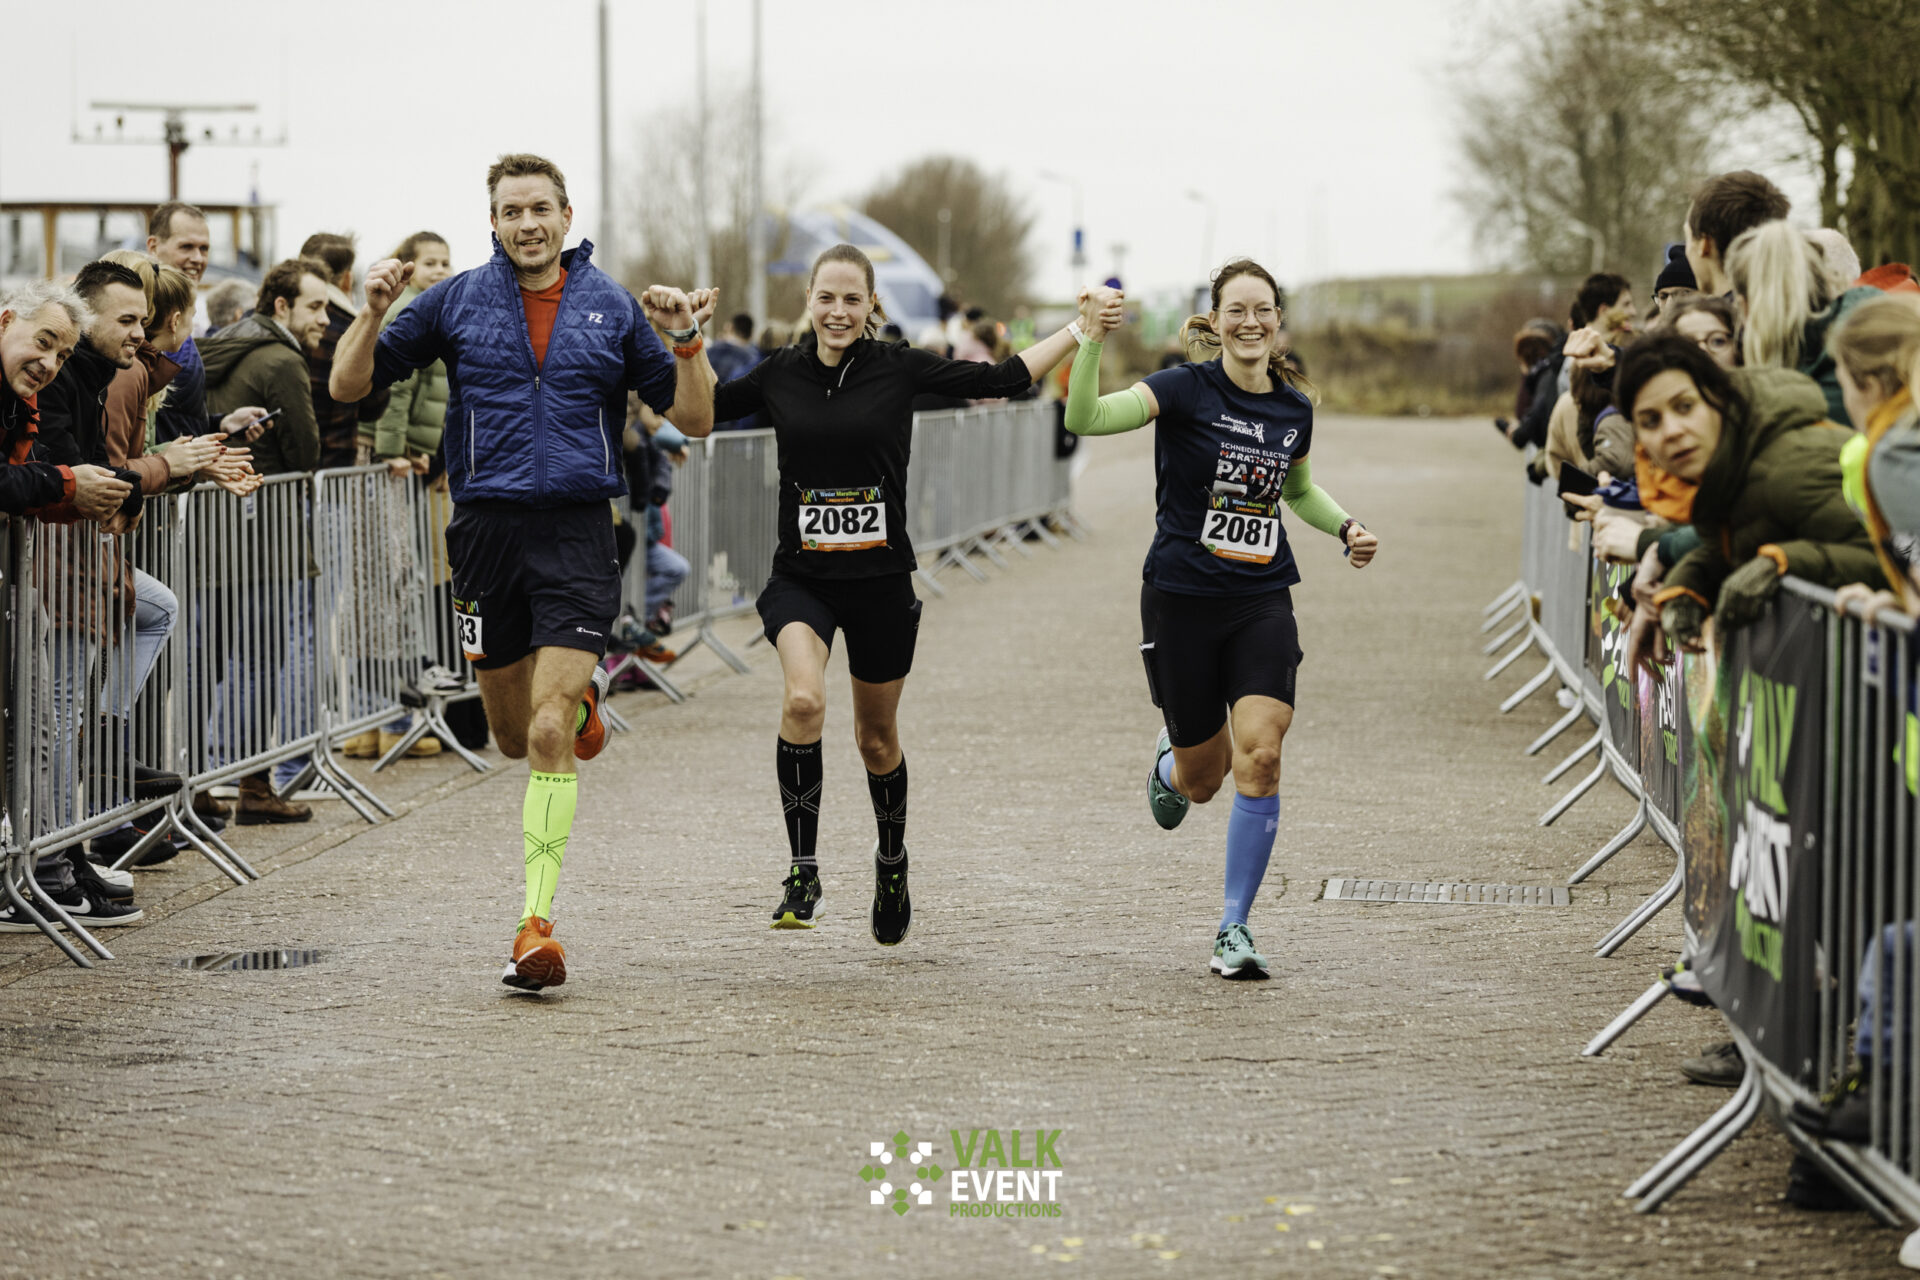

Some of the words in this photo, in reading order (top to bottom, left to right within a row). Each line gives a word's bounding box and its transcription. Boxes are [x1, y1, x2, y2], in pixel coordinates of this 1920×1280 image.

[588, 312, 604, 324] FZ
[1220, 414, 1248, 426] Schneider
[1233, 426, 1253, 436] PARIS
[1221, 441, 1261, 456] SCHNEIDER
[1262, 450, 1291, 461] ELECTRIC
[1219, 449, 1279, 467] MARATHON
[1280, 460, 1289, 470] DE
[1216, 458, 1286, 493] PARIS
[804, 506, 880, 535] 2082
[1207, 513, 1273, 547] 2081
[782, 745, 814, 755] STOX
[536, 775, 571, 784] STOX
